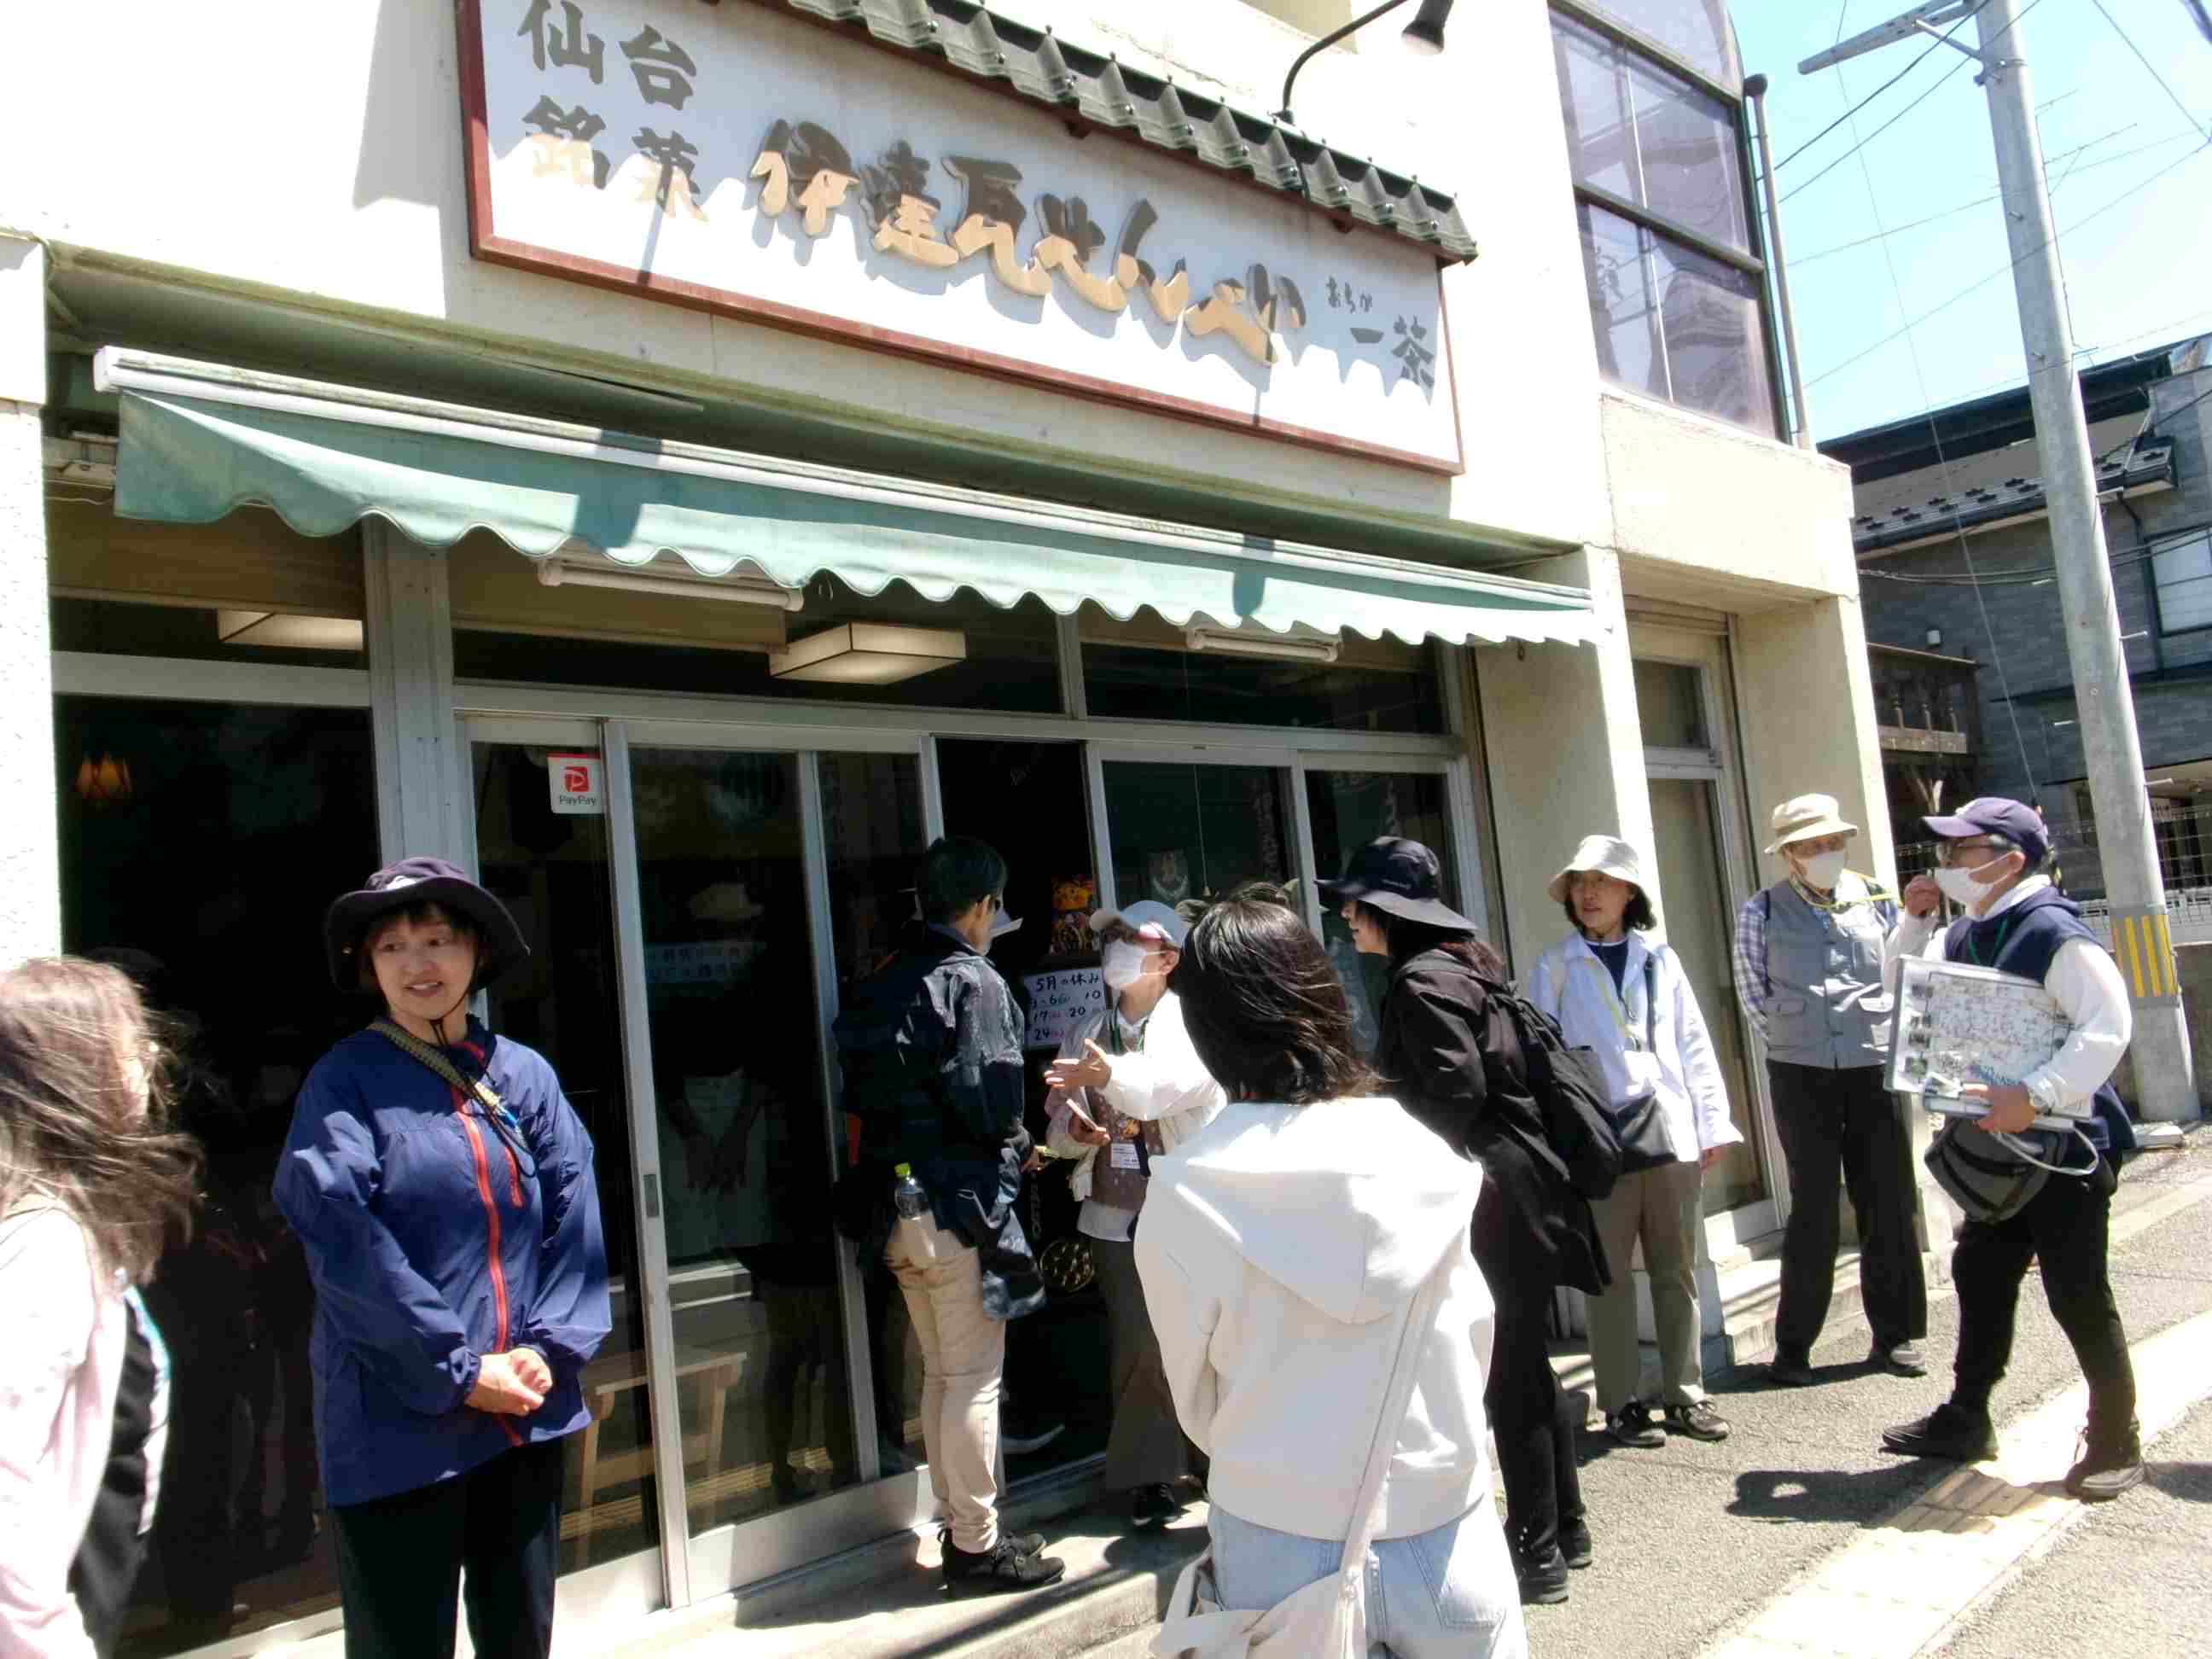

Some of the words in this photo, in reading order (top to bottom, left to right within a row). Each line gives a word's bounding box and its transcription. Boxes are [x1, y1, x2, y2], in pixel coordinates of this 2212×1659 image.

[517, 0, 697, 111] 仙台
[521, 94, 707, 223] 銘菓
[559, 794, 597, 806] PayPay
